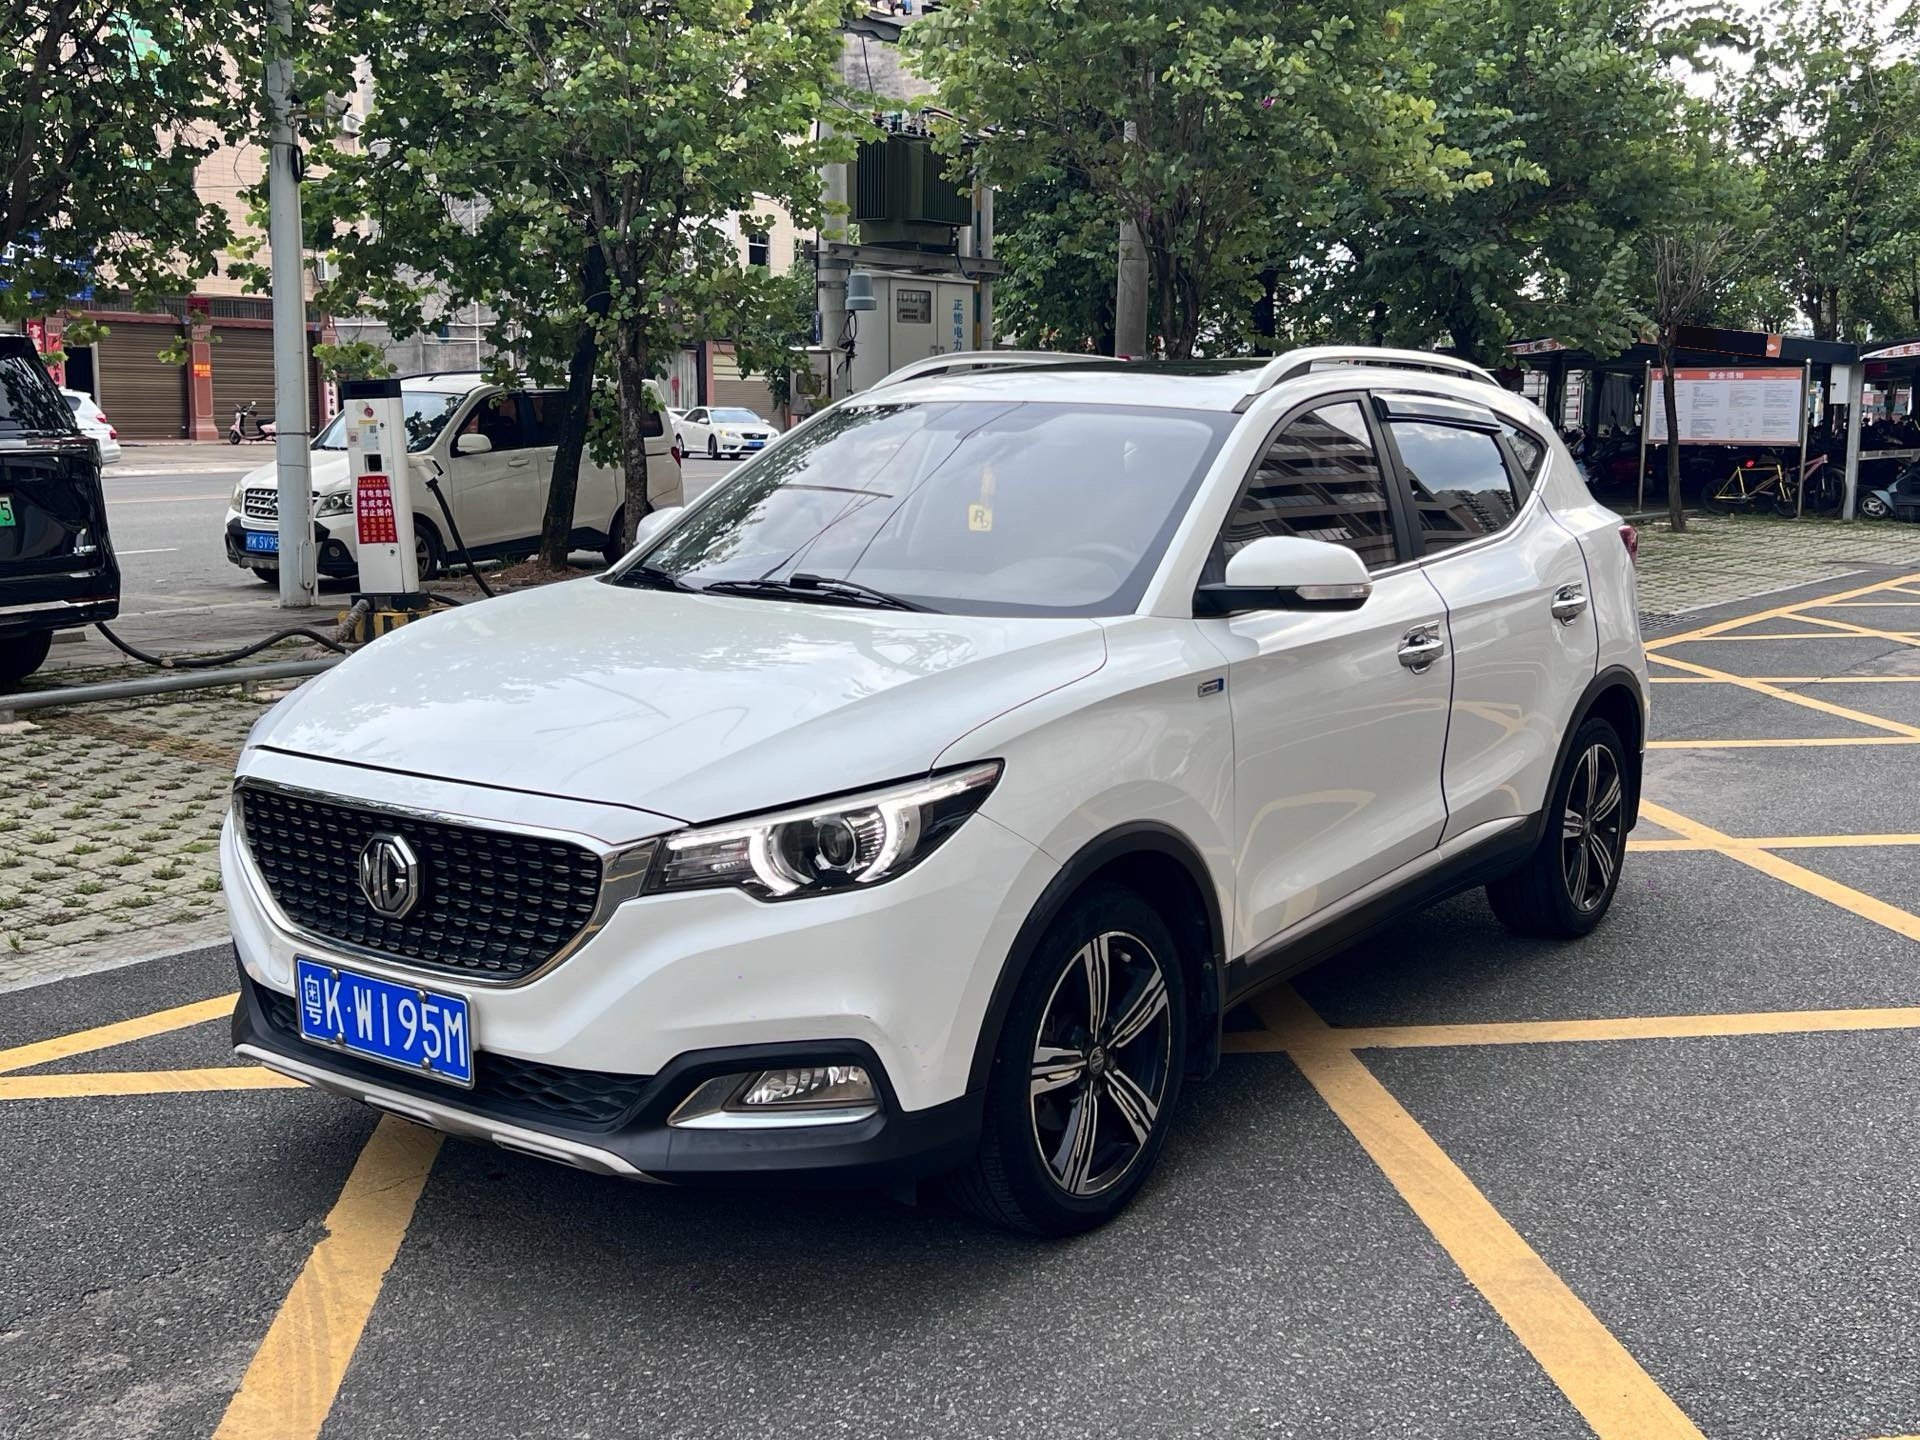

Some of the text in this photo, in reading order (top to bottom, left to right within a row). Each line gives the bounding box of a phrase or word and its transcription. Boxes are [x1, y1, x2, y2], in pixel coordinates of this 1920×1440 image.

[361, 508, 392, 517] 禁止操作
[362, 842, 407, 911] MG
[303, 973, 466, 1068] 粤K·W195M
